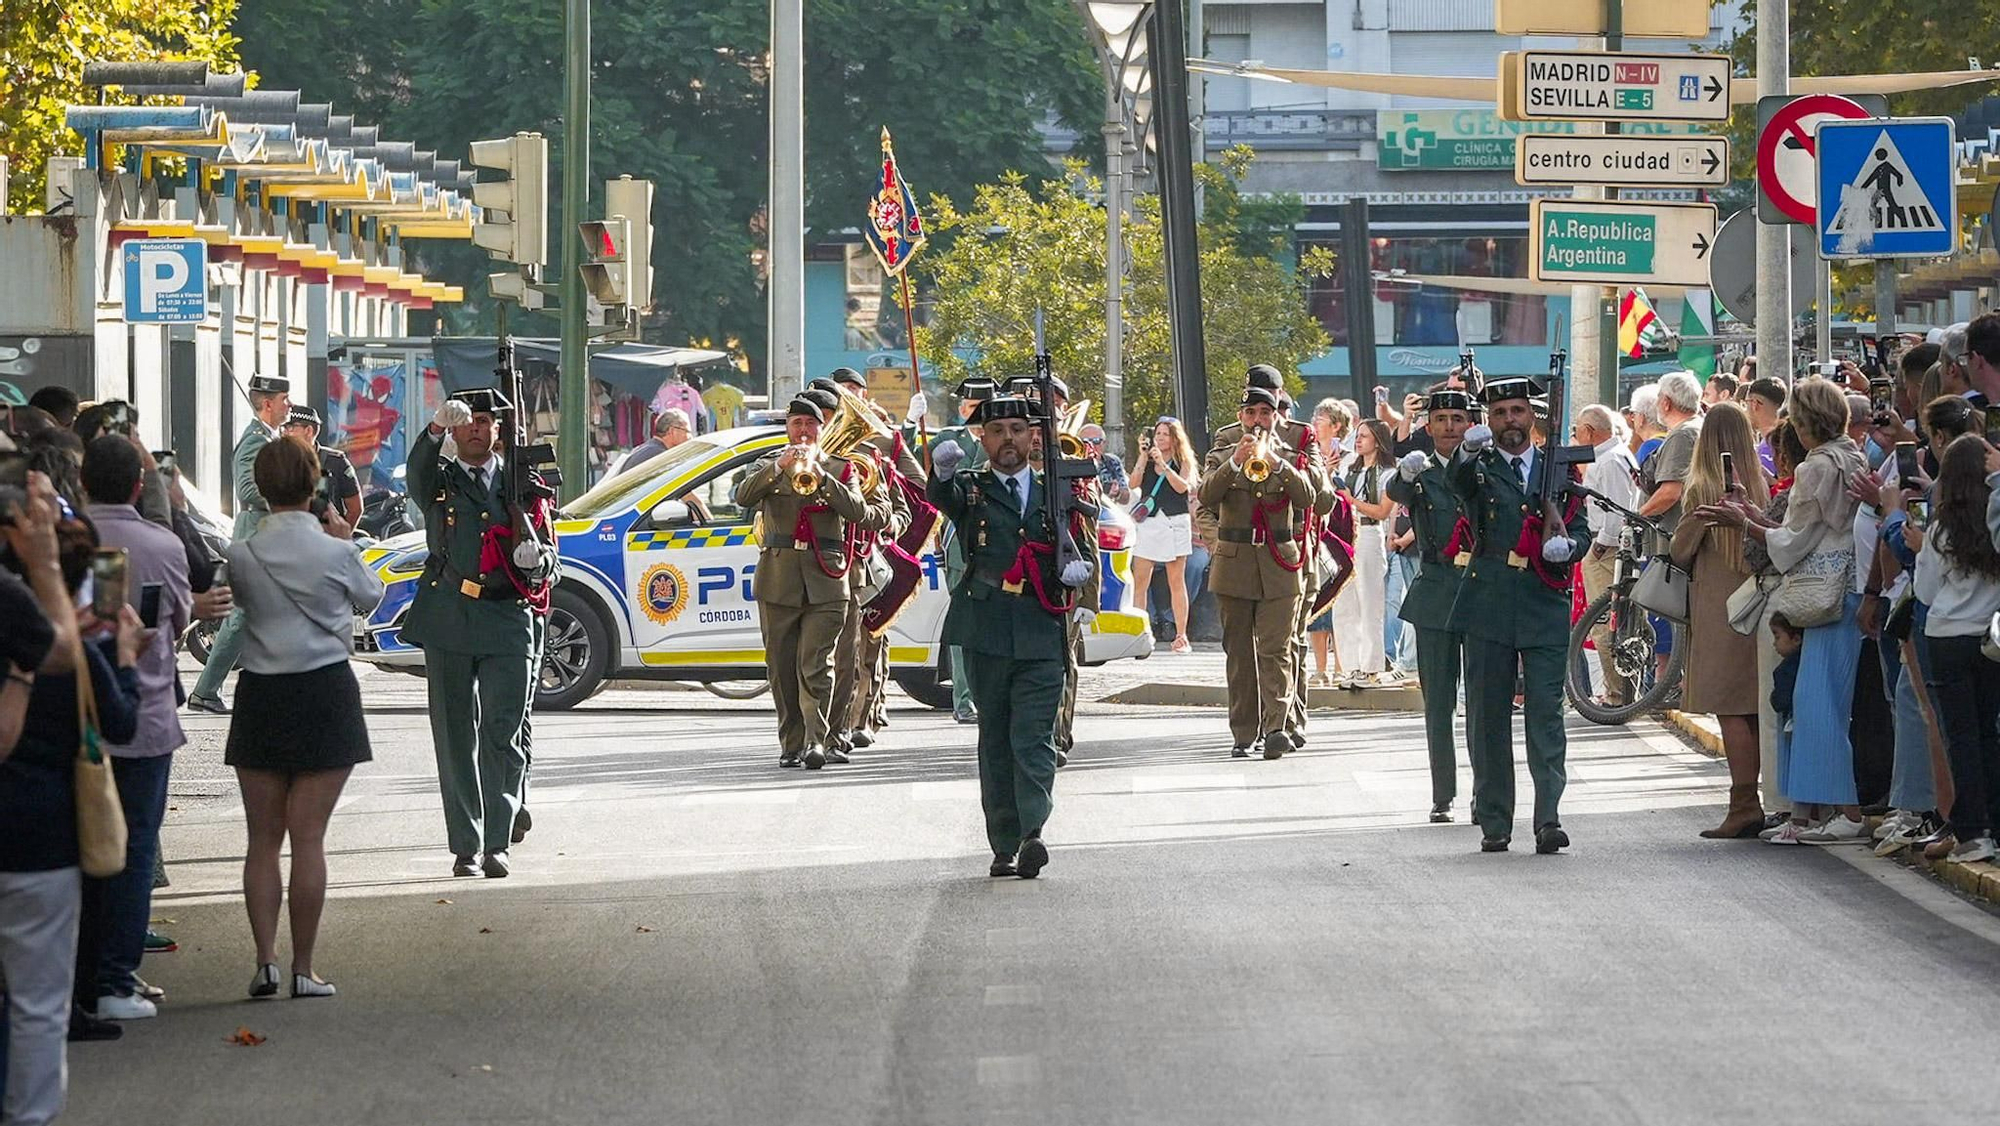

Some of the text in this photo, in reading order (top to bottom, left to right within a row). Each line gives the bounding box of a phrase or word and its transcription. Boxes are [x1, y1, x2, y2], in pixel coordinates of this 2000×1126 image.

[1530, 62, 1659, 82] MADRID N-IV
[1530, 87, 1610, 108] SEVILLA
[1454, 141, 1501, 154] CLÍNICA
[1529, 151, 1592, 170] centro
[1602, 151, 1670, 171] ciudad
[1547, 218, 1653, 243] A.Republica
[1546, 244, 1626, 268] Argentina
[140, 250, 190, 314] P
[699, 609, 751, 623] CÓRDOBA
